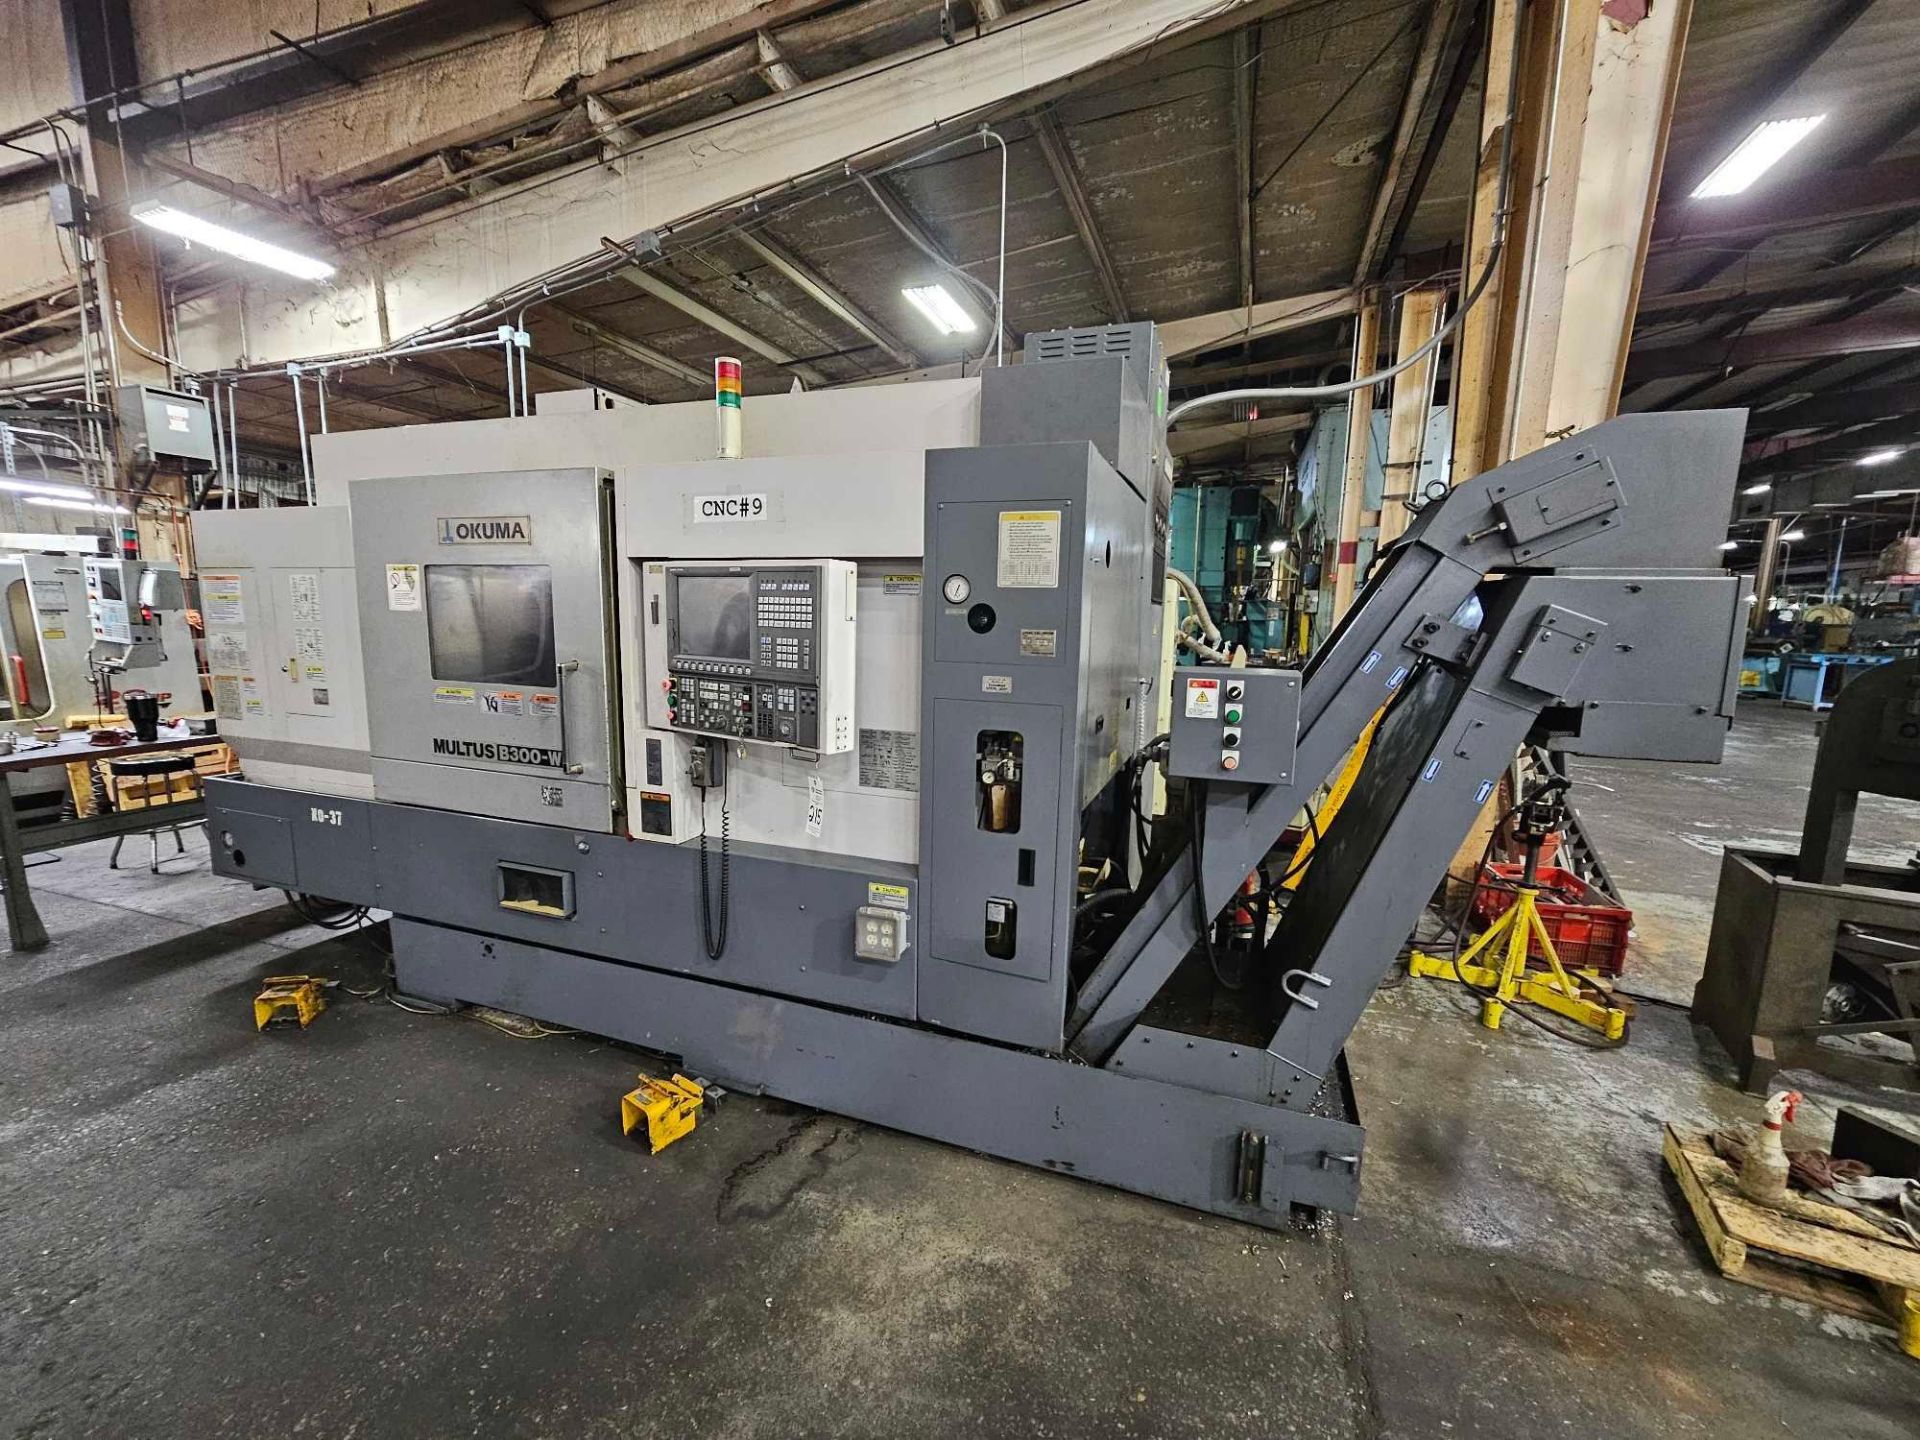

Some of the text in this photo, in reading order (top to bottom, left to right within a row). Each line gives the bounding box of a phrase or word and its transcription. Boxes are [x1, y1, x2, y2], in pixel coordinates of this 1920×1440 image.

[702, 497, 763, 517] CNC#9
[456, 522, 525, 539] OKUMA
[433, 738, 562, 766] MULTUS B300-W
